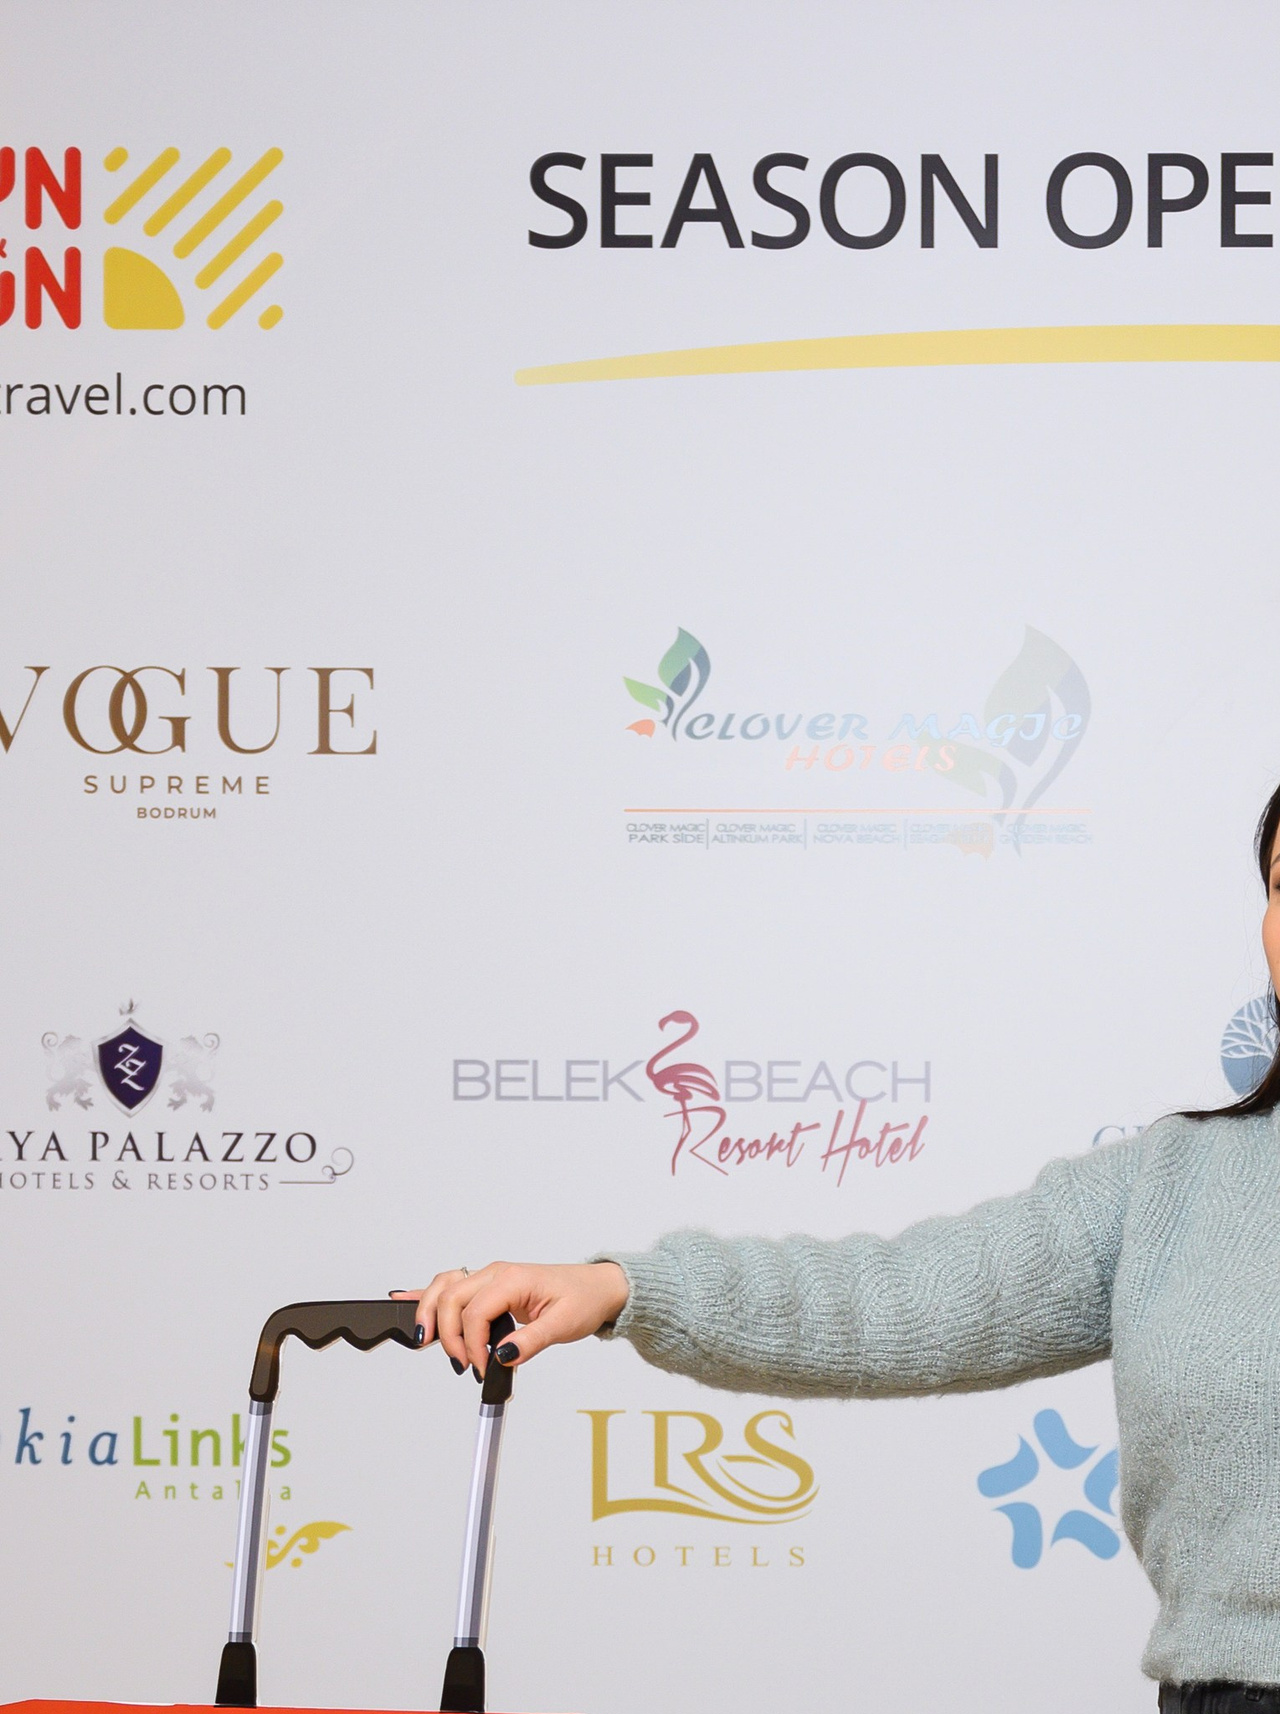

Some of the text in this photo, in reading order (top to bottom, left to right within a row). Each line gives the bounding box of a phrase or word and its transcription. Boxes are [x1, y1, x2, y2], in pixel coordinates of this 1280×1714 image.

[524, 152, 1001, 251] SEASON
[0, 372, 246, 416] ravel.com
[685, 712, 1084, 746] CLOVER MAGIC
[785, 744, 959, 772] HOTELS
[83, 775, 270, 795] SUPREME
[136, 807, 217, 820] BODRUM
[628, 834, 669, 844] PARK
[453, 1059, 931, 1103] BELEK BEACH
[88, 1130, 318, 1164] PALAZZO
[664, 1100, 929, 1188] Resort Hotel
[0, 1169, 270, 1192] OTELS & RESORTS
[576, 1408, 820, 1525] LRS
[592, 1546, 806, 1567] HOTELS
